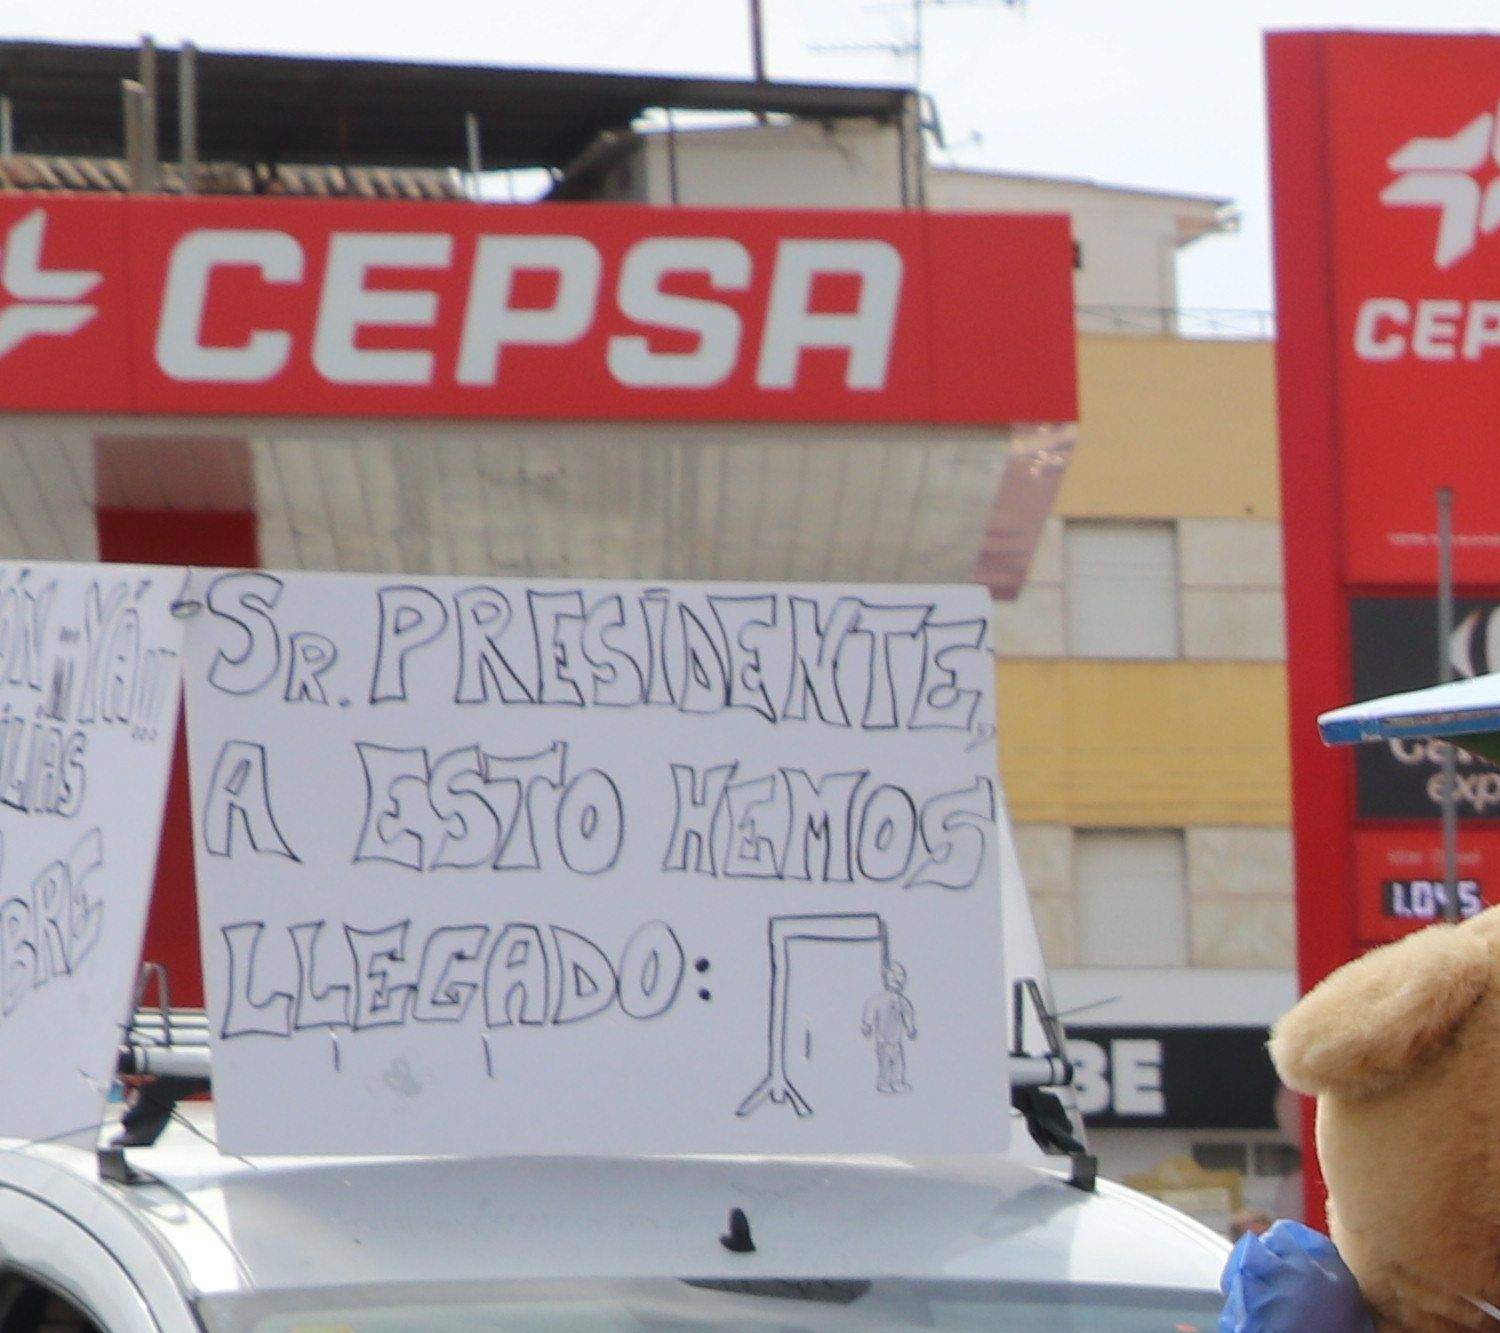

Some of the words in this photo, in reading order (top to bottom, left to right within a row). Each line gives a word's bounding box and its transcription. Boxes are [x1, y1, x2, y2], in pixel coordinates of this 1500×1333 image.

[155, 228, 903, 392] CEPSA
[203, 741, 306, 864] A
[352, 740, 626, 873] ESTO
[662, 761, 997, 891] HEMOS
[220, 919, 715, 1040] LLEGADO:
